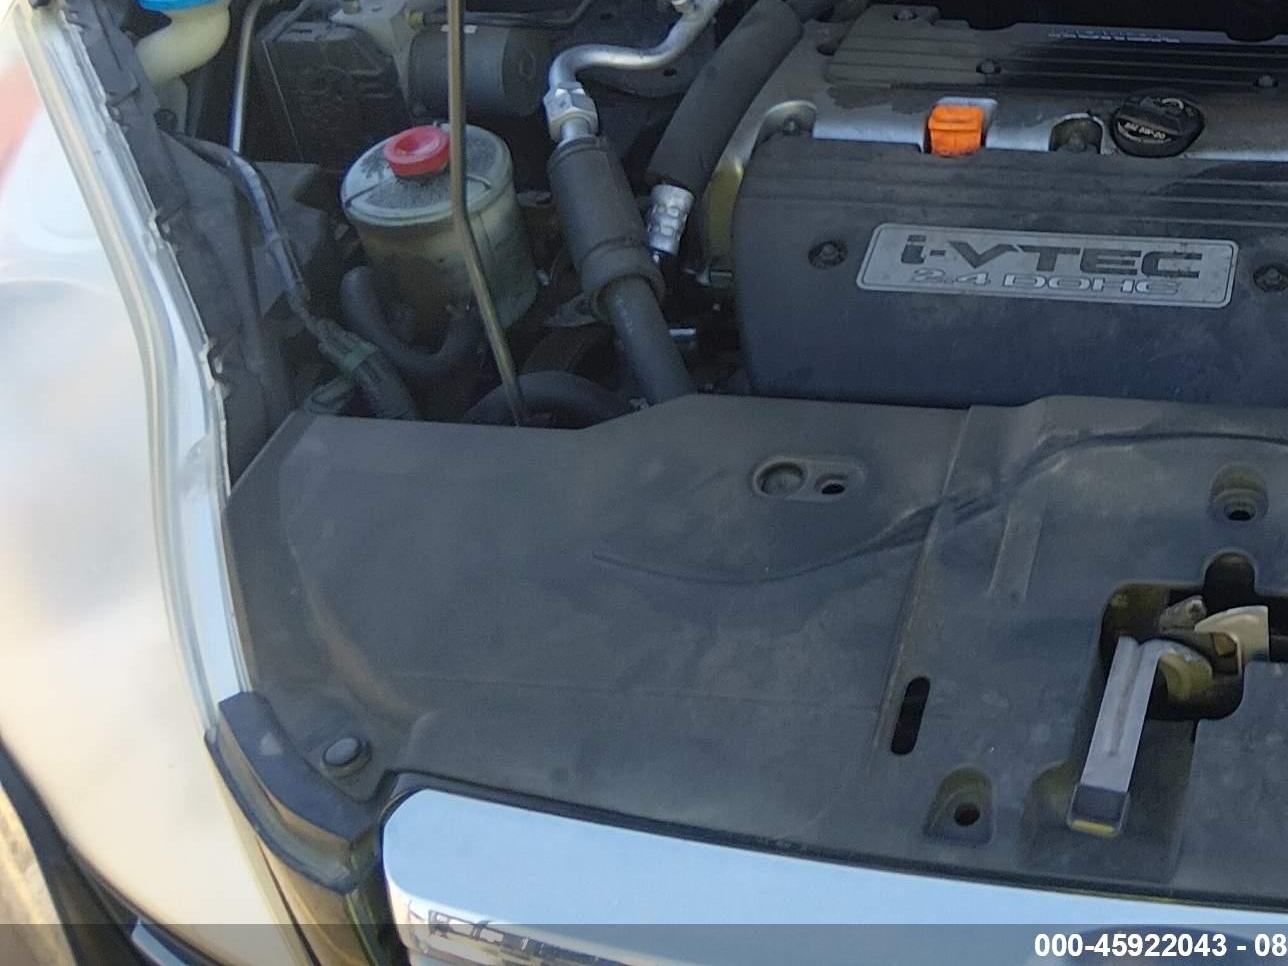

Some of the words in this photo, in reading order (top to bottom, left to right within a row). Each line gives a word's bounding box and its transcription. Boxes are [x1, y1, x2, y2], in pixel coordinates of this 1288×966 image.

[900, 234, 1203, 279] i-VTEC
[912, 268, 991, 286] 2.4
[1001, 272, 1183, 296] DOHC
